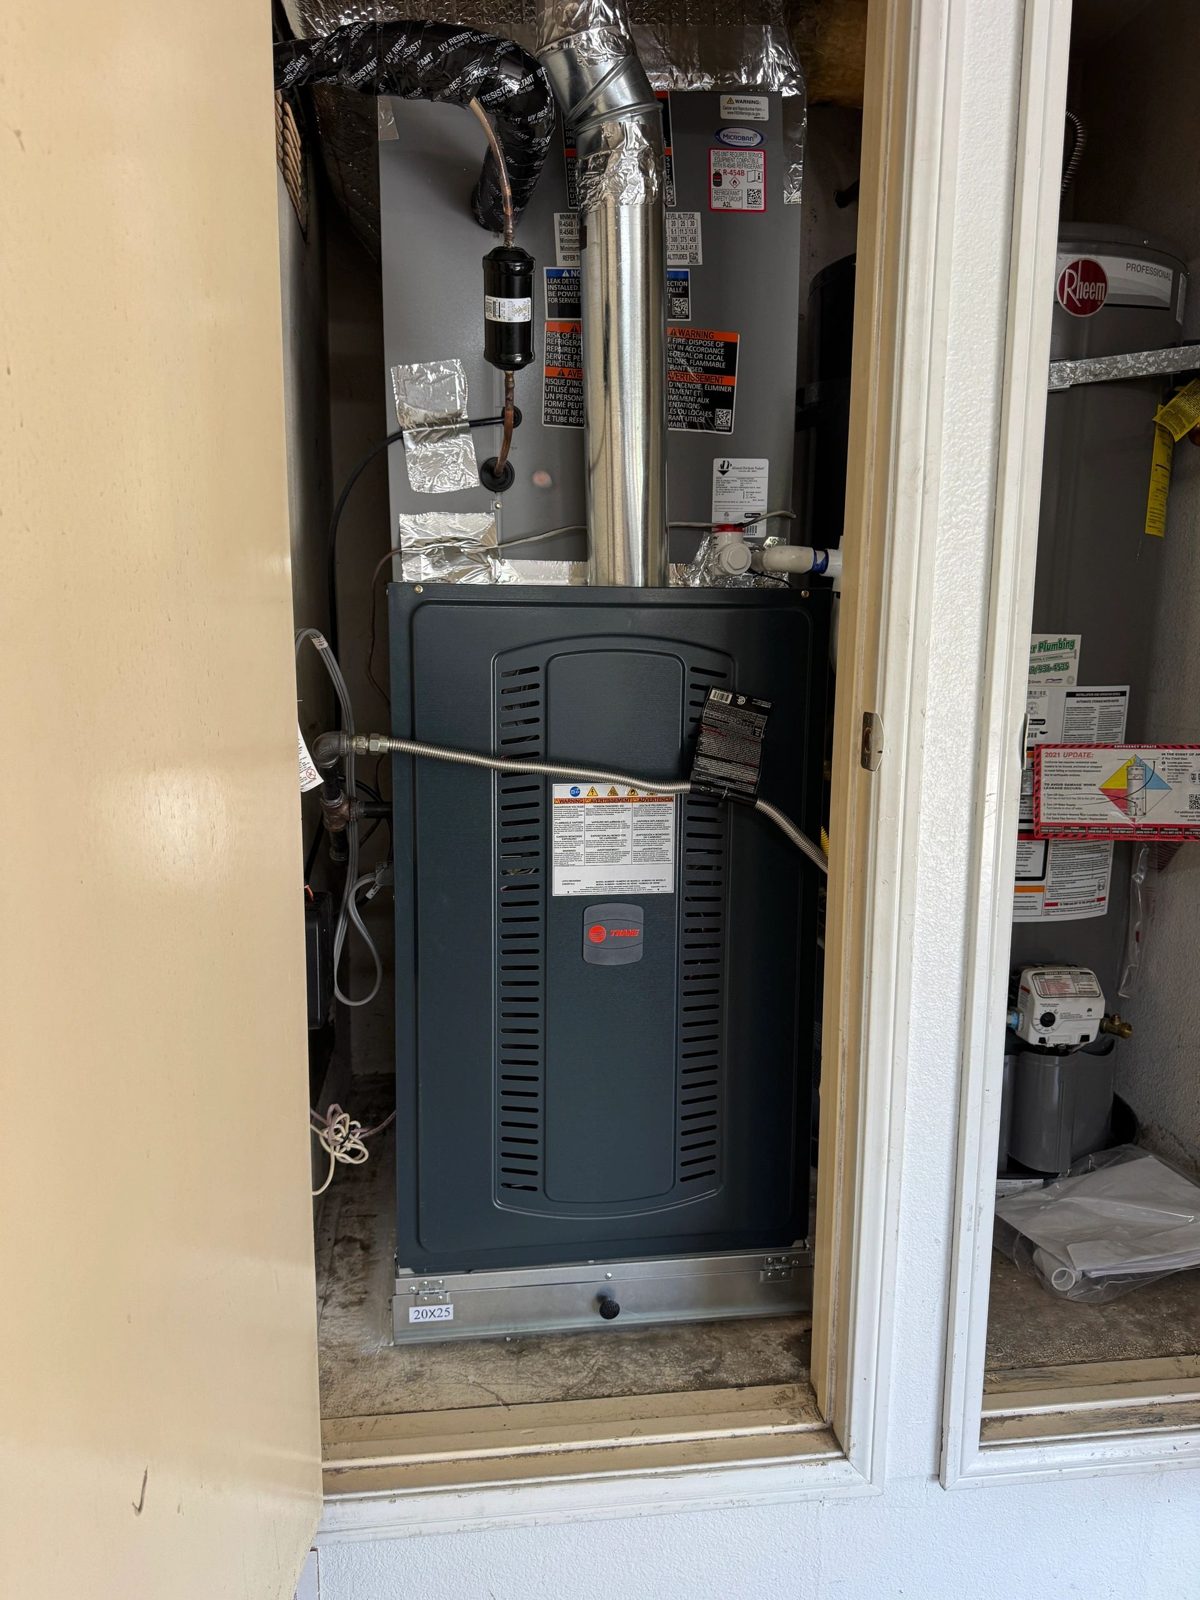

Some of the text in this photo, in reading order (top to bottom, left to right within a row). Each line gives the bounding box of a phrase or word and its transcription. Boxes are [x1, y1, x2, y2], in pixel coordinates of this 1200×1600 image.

[438, 42, 448, 52] UV
[1126, 262, 1171, 281] PROFESSIONAL
[1063, 261, 1106, 307] Rheem
[680, 330, 714, 339] WARNING
[688, 339, 714, 347] DISPOSE
[684, 346, 724, 354] ACCORDANCE
[690, 360, 726, 369] FLAMMABLE
[1038, 637, 1076, 652] Plumbing
[610, 928, 640, 936] TRANE
[414, 1307, 450, 1320] 20X25
